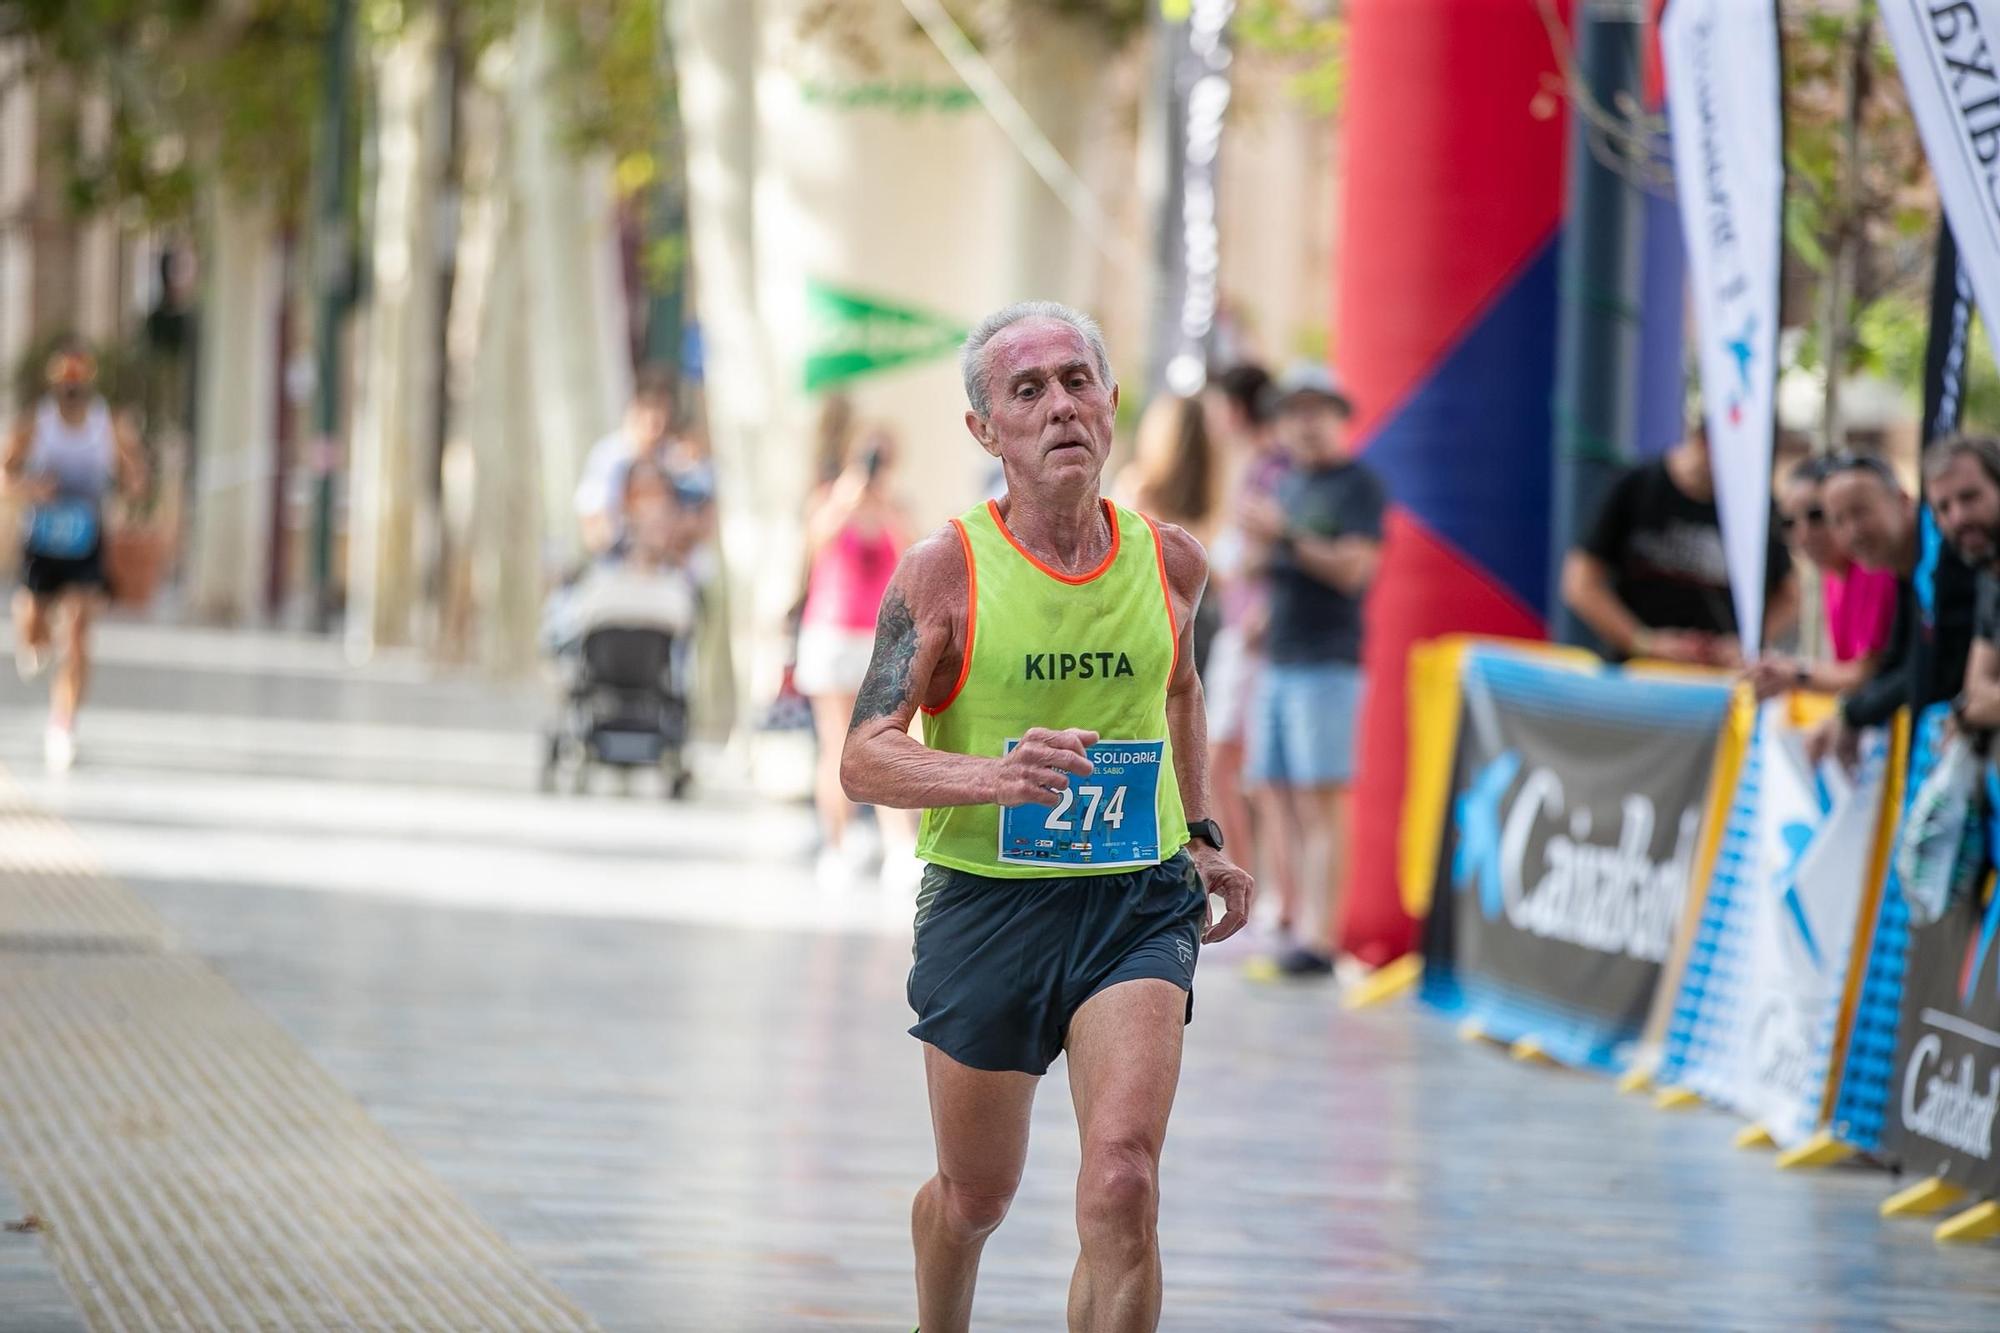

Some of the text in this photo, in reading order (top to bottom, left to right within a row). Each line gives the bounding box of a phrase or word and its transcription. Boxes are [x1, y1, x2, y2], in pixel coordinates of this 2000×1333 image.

[1025, 652, 1134, 680] KIPSTA
[1103, 767, 1125, 775] SABIO
[1044, 785, 1127, 831] 274
